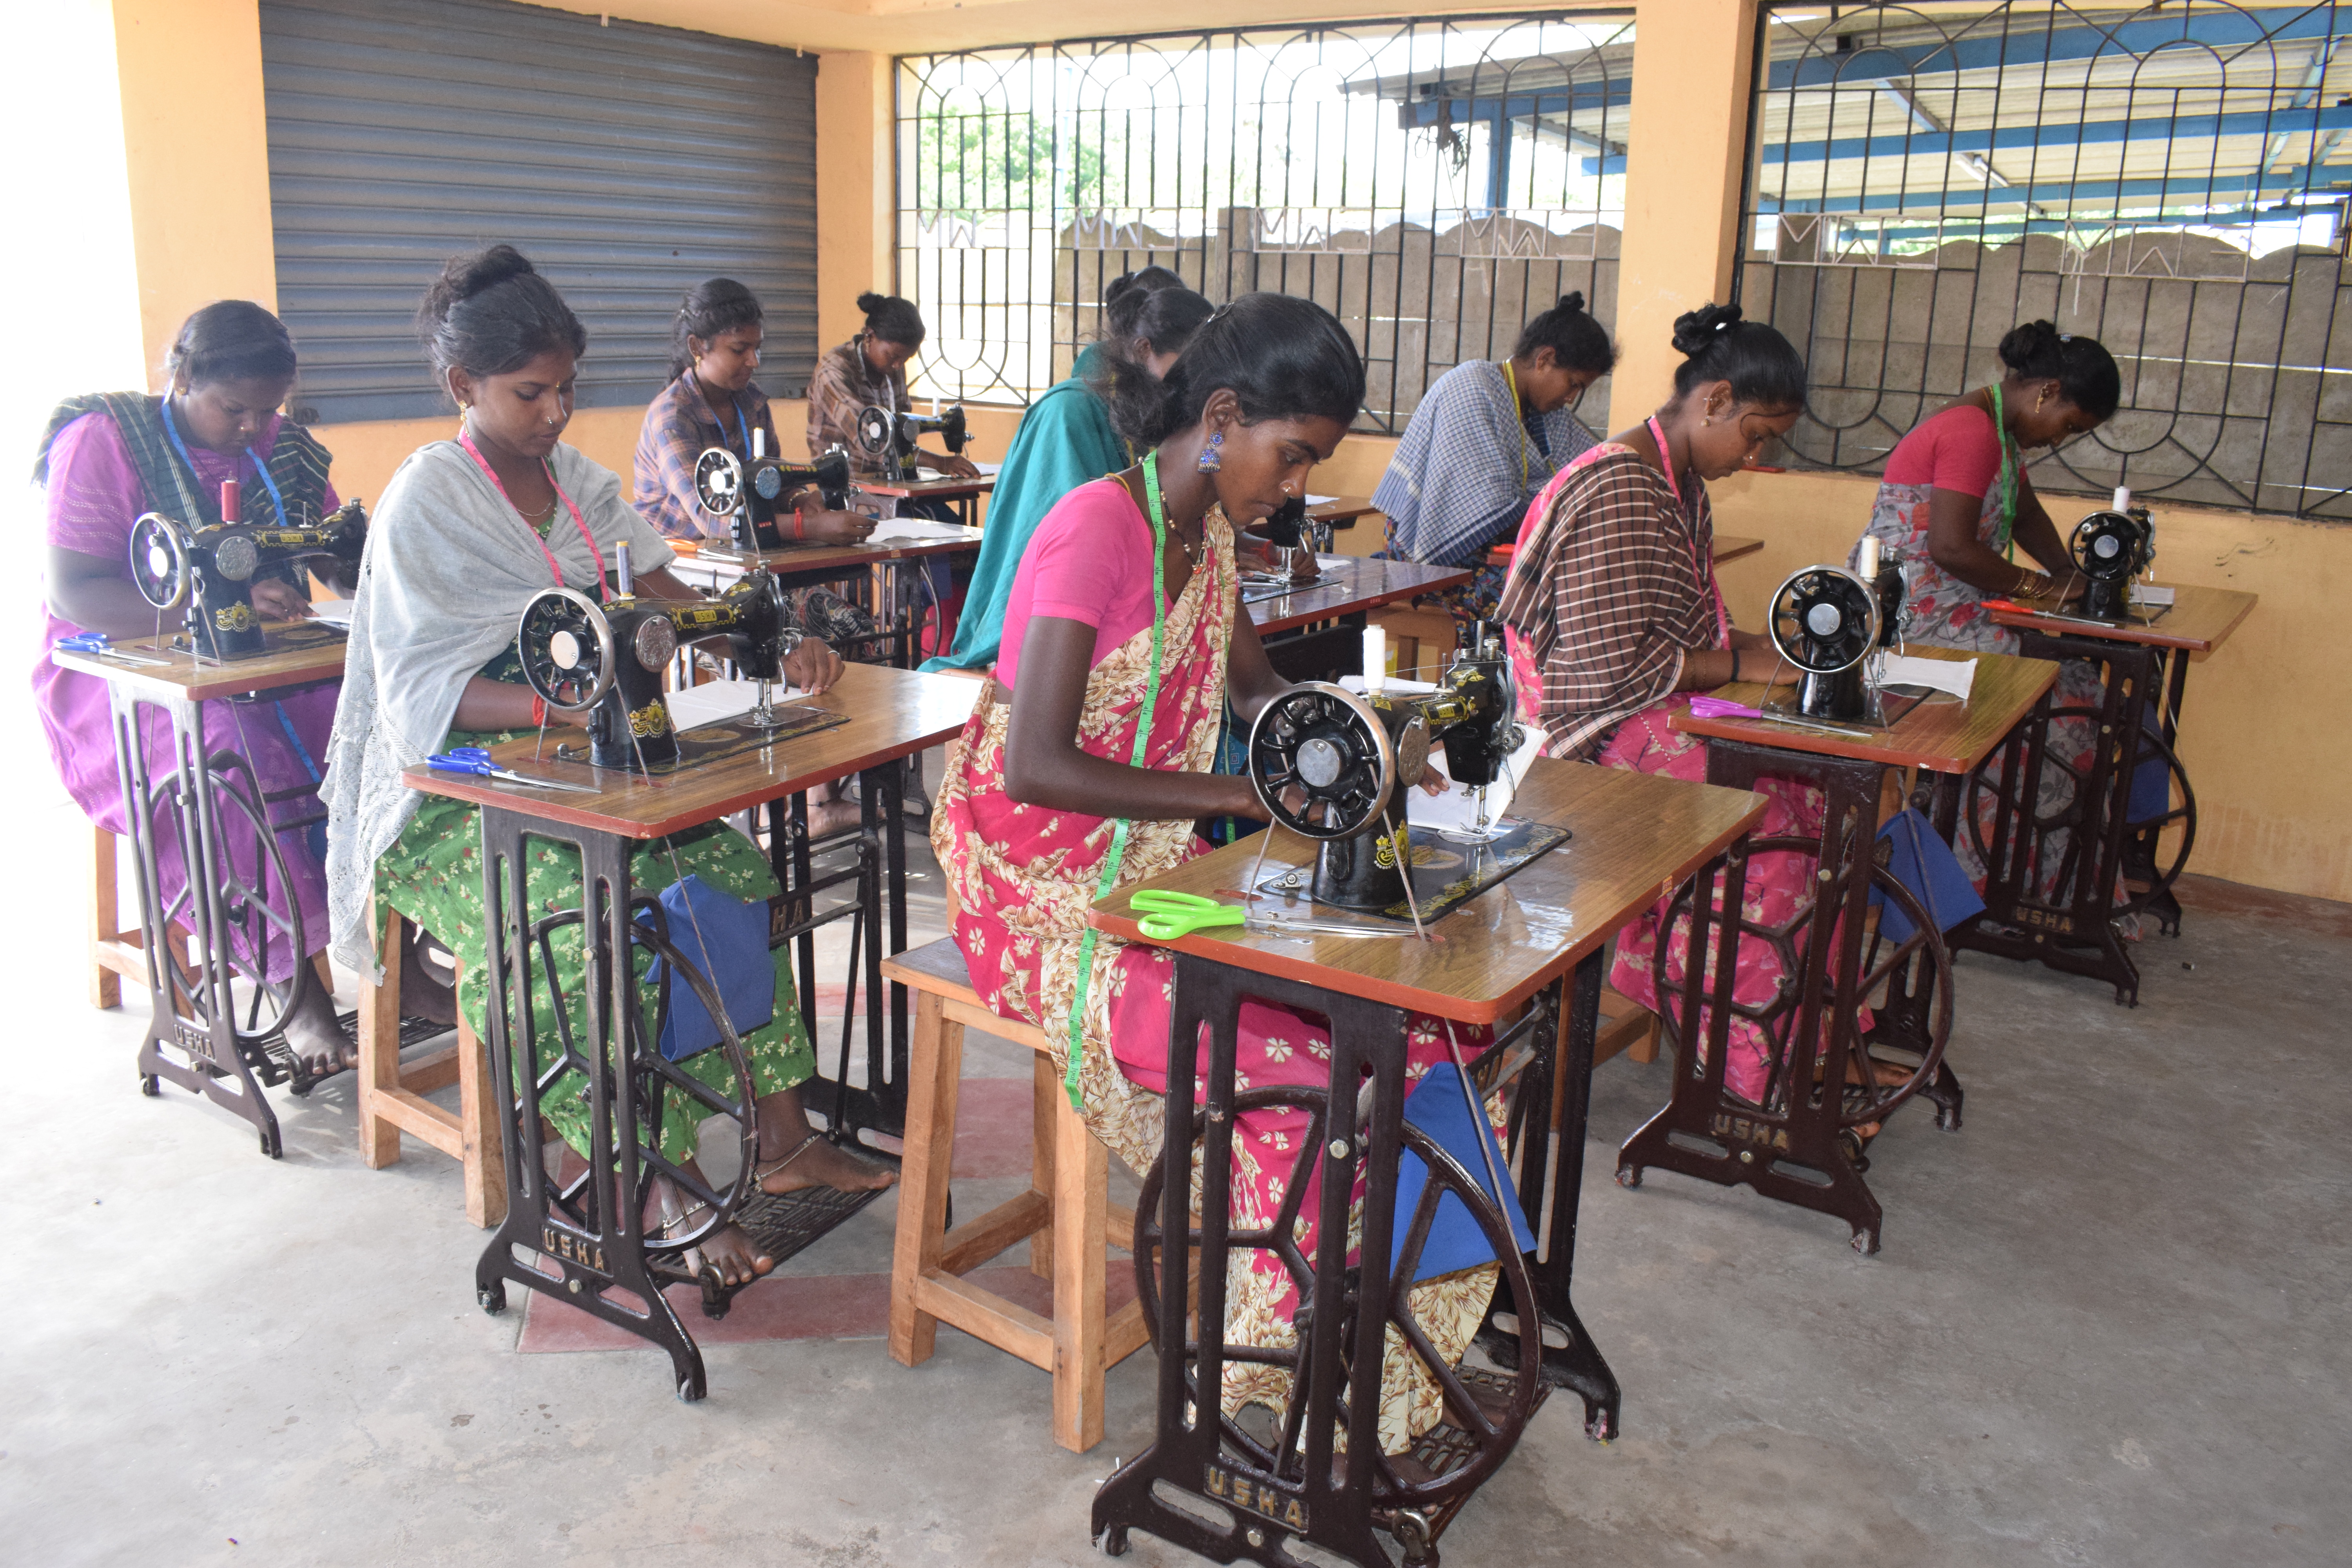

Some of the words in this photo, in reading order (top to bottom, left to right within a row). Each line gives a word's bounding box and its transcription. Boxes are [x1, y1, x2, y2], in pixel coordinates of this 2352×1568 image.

[1146, 476, 1151, 485] 34
[1149, 498, 1154, 507] 35
[1152, 660, 1156, 669] 42
[1148, 684, 1154, 692] 43
[1113, 840, 1119, 849] 50
[773, 900, 804, 934] HA
[2015, 906, 2072, 932] USHA
[1082, 944, 1087, 953] 55
[1080, 967, 1085, 976] 56
[1076, 991, 1082, 1000] 57
[174, 1024, 216, 1059] USHA
[1071, 1033, 1076, 1042] 59
[1071, 1055, 1076, 1065] 60
[1069, 1067, 1078, 1084] Jyoti
[1714, 1113, 1788, 1151] USHA
[544, 1227, 605, 1271] USHA
[1209, 1466, 1303, 1528] USHA
